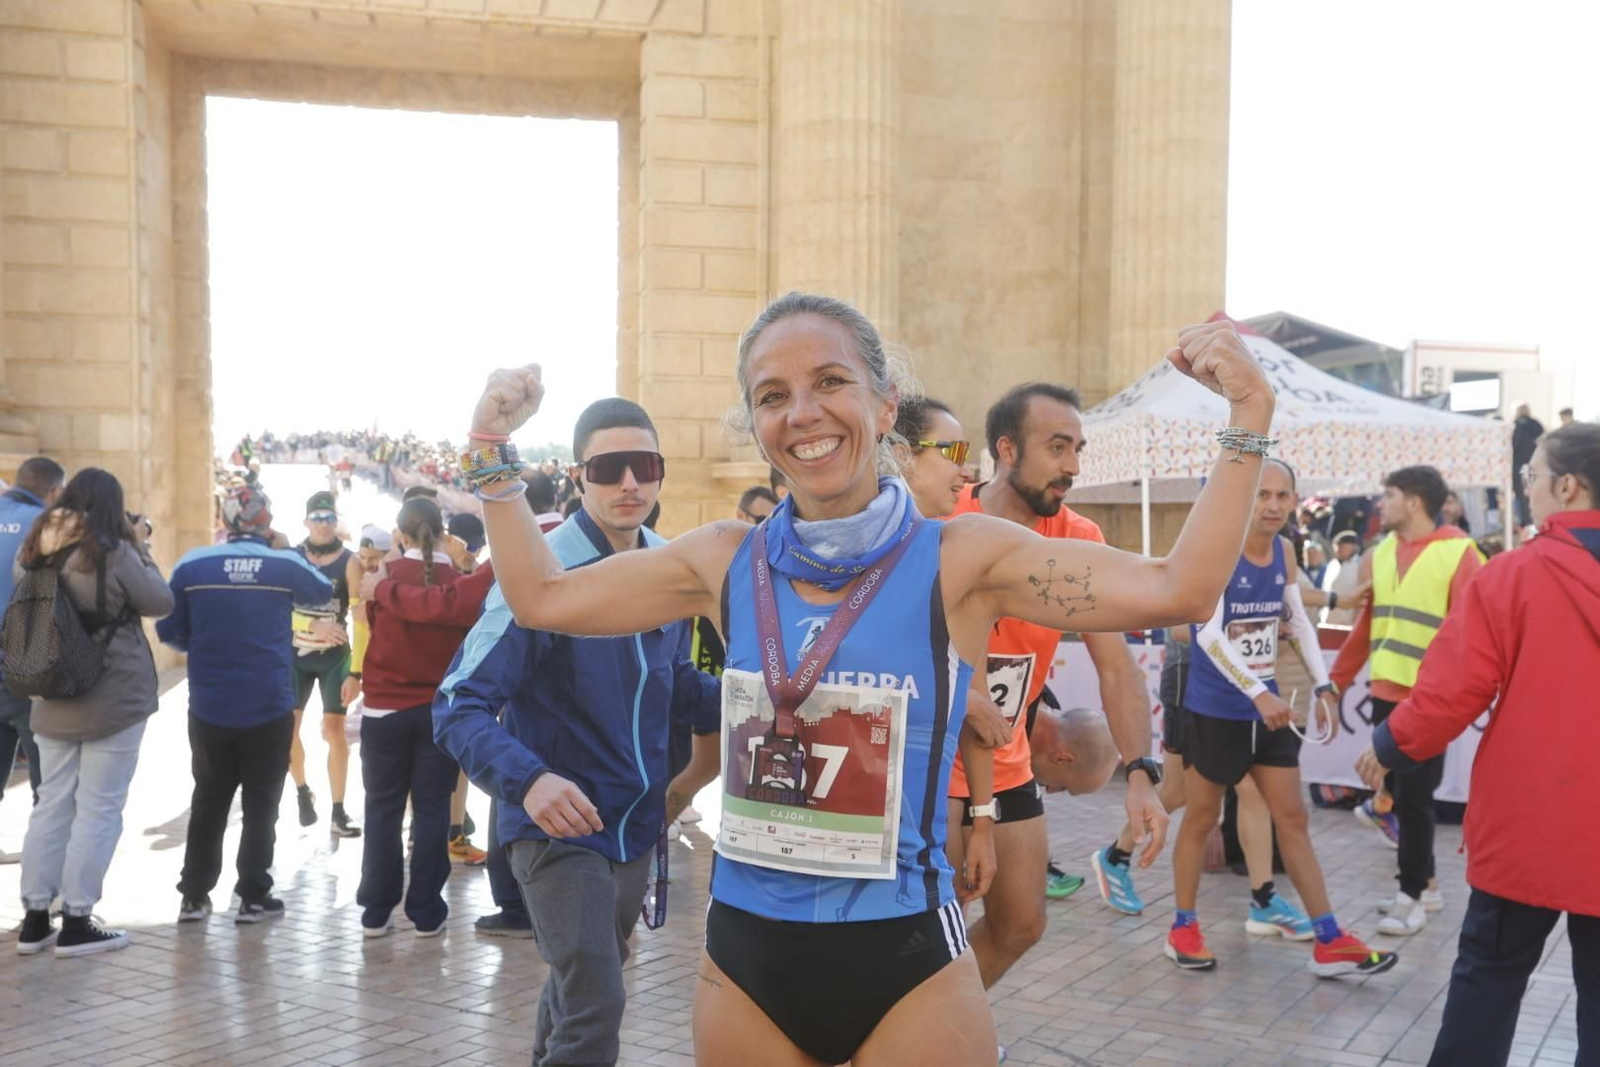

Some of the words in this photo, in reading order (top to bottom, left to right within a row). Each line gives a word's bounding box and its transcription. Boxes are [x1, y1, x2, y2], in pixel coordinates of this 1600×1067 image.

[223, 558, 263, 572] STAFF
[830, 564, 845, 574] de
[756, 559, 765, 586] MEDIA
[765, 637, 781, 687] CORDOBA
[797, 658, 820, 692] MEDIA
[849, 567, 884, 610] CORDOBA
[1241, 638, 1272, 657] 326
[748, 736, 850, 799] 17
